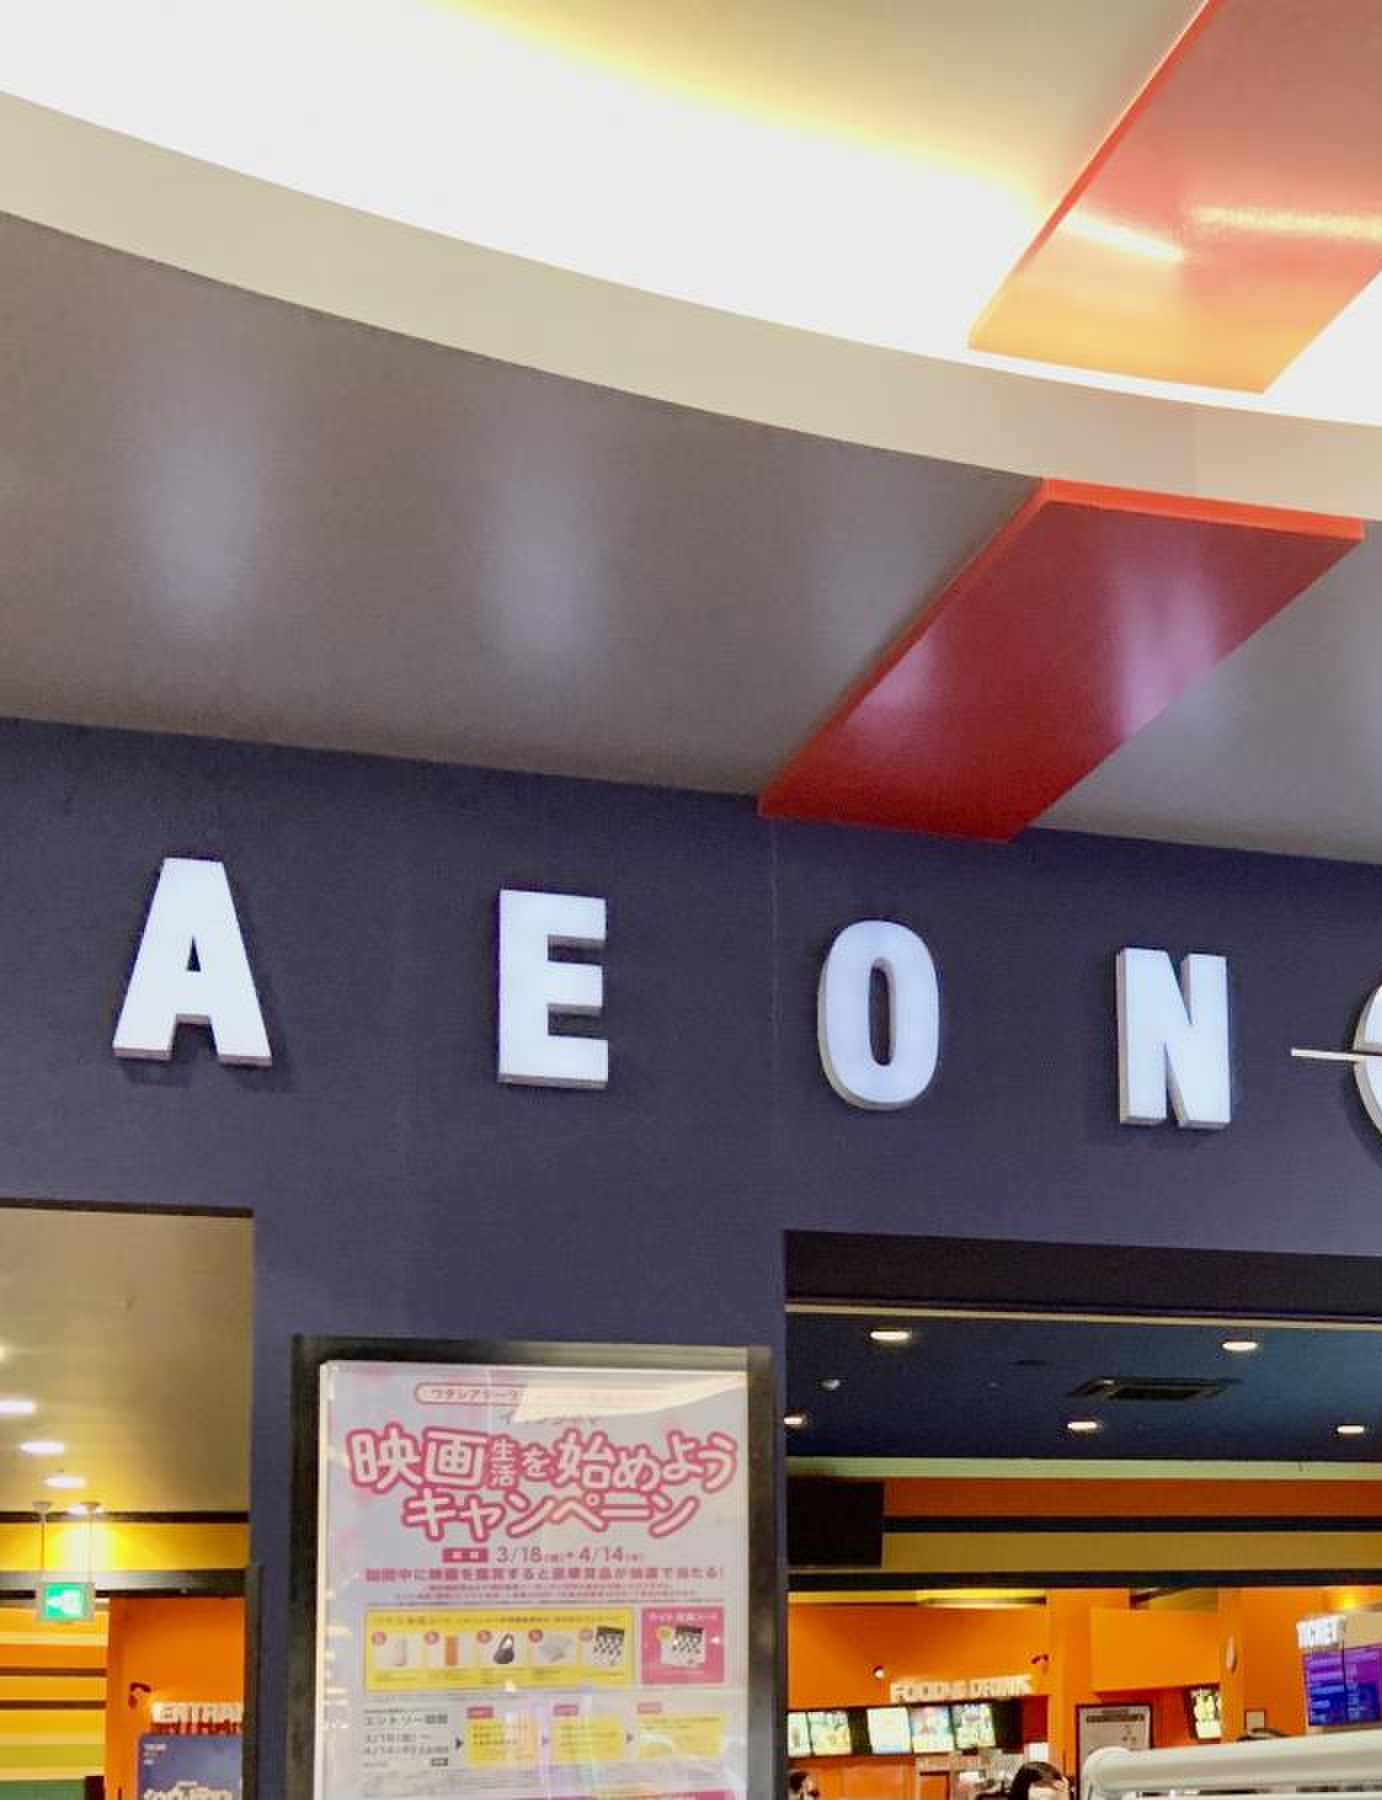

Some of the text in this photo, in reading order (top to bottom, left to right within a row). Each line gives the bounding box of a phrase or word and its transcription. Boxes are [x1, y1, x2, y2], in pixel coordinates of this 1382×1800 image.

[113, 856, 1231, 1130] AEON
[402, 1487, 701, 1541] キャンペーン
